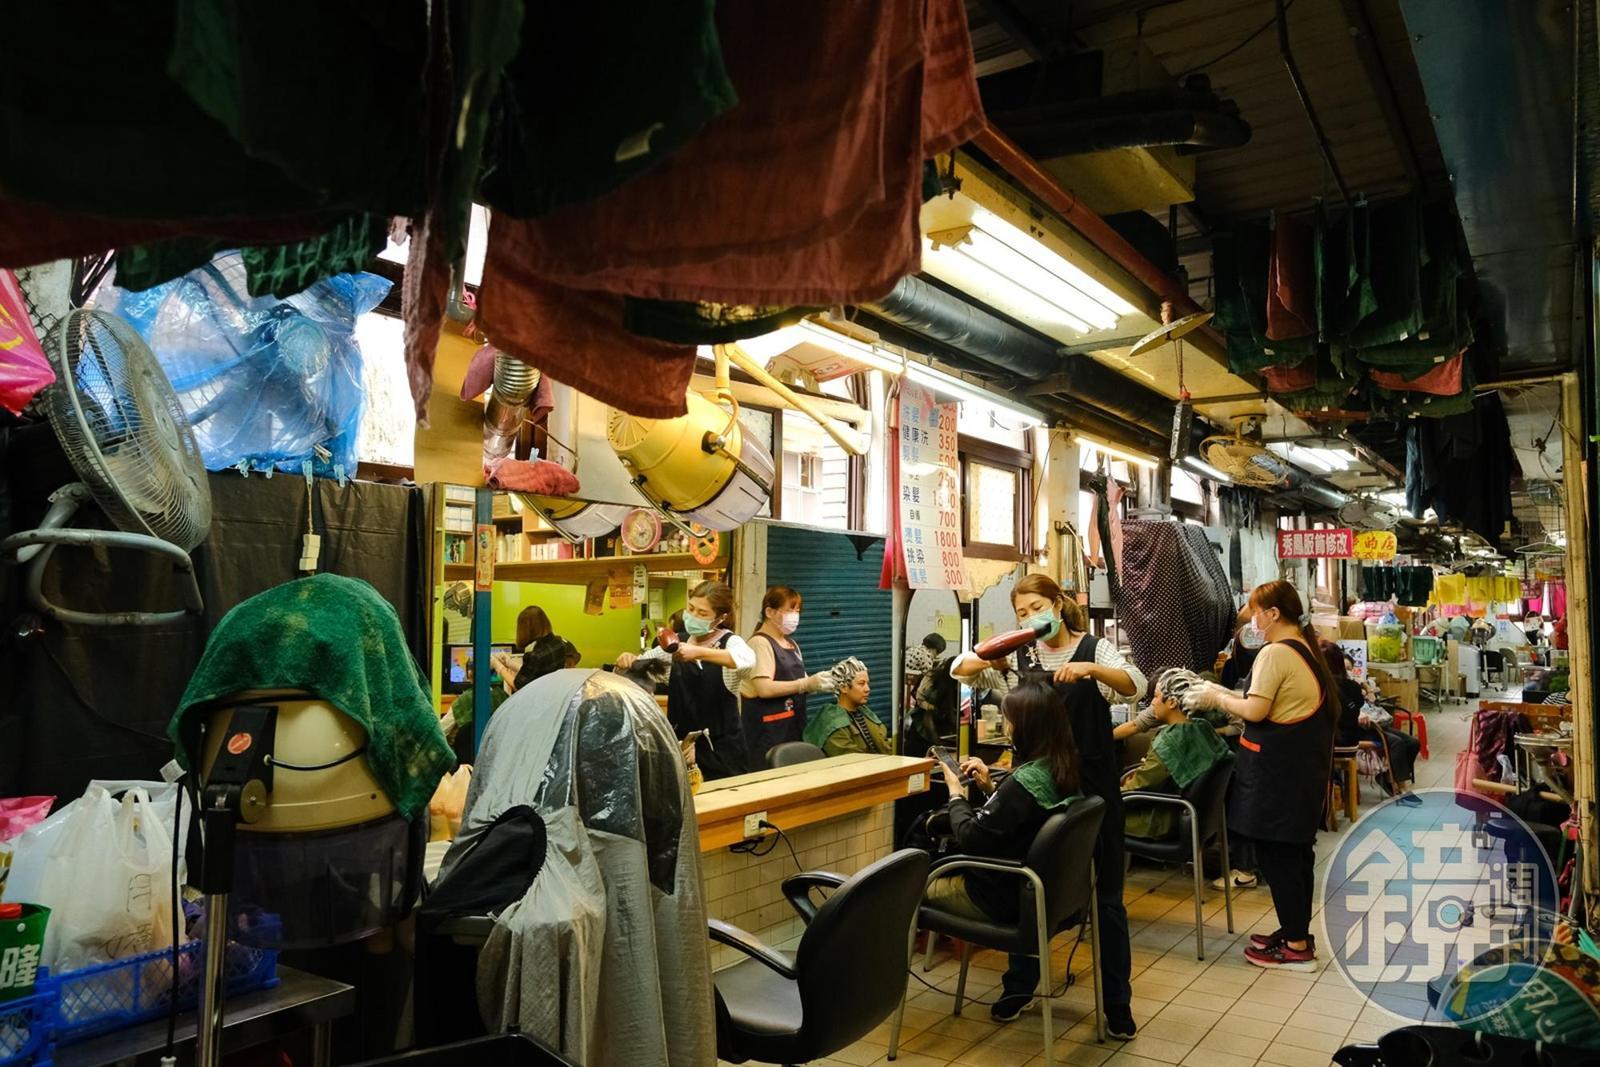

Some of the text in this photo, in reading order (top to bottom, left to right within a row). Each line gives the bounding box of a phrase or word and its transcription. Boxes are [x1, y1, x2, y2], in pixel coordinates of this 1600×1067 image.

[939, 414, 955, 432] 200
[939, 433, 955, 452] 350
[903, 485, 920, 503] 染髮
[939, 511, 956, 528] 700
[934, 530, 957, 547] 1800
[942, 551, 960, 567] 800
[945, 569, 963, 585] 300
